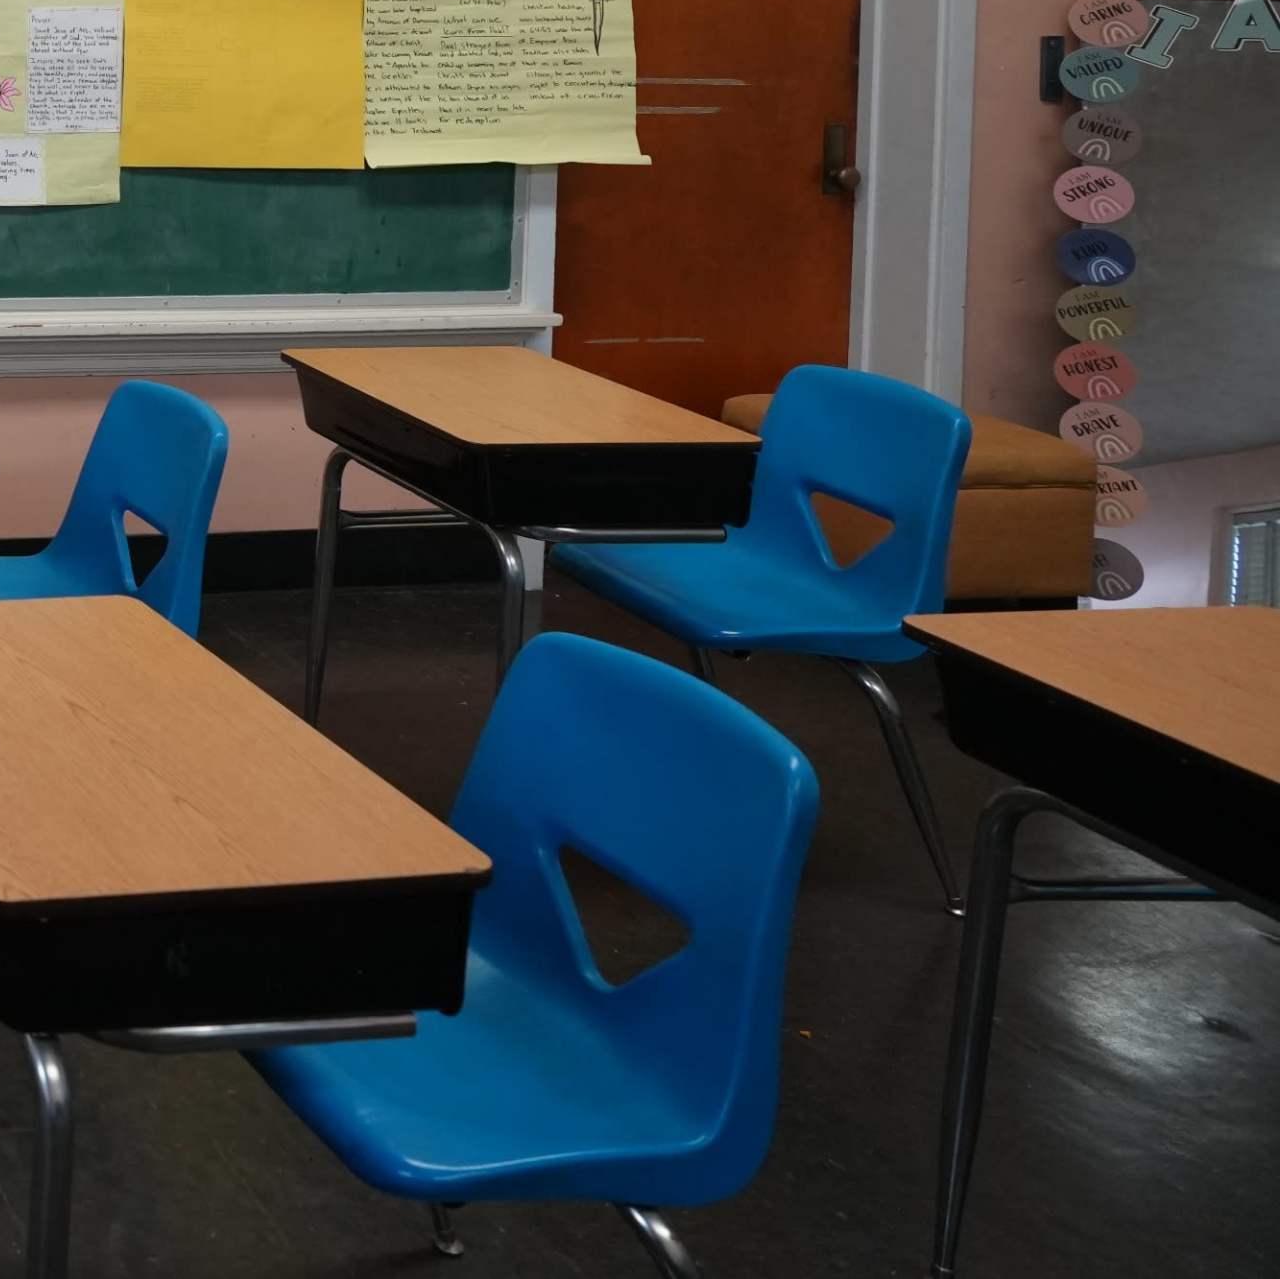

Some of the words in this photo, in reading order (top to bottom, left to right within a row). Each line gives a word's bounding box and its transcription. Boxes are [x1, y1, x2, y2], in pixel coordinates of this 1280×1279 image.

[443, 16, 466, 24] What
[1080, 1, 1133, 25] CARING
[1124, 4, 1200, 69] I
[1065, 56, 1124, 80] VALUED
[1078, 117, 1134, 142] UNIQUE
[1063, 176, 1116, 203] STRONG
[1071, 240, 1109, 261] KIND
[1058, 297, 1130, 319] POWERFUL
[1063, 356, 1119, 376] HONEST
[1072, 414, 1120, 438] BRAVE
